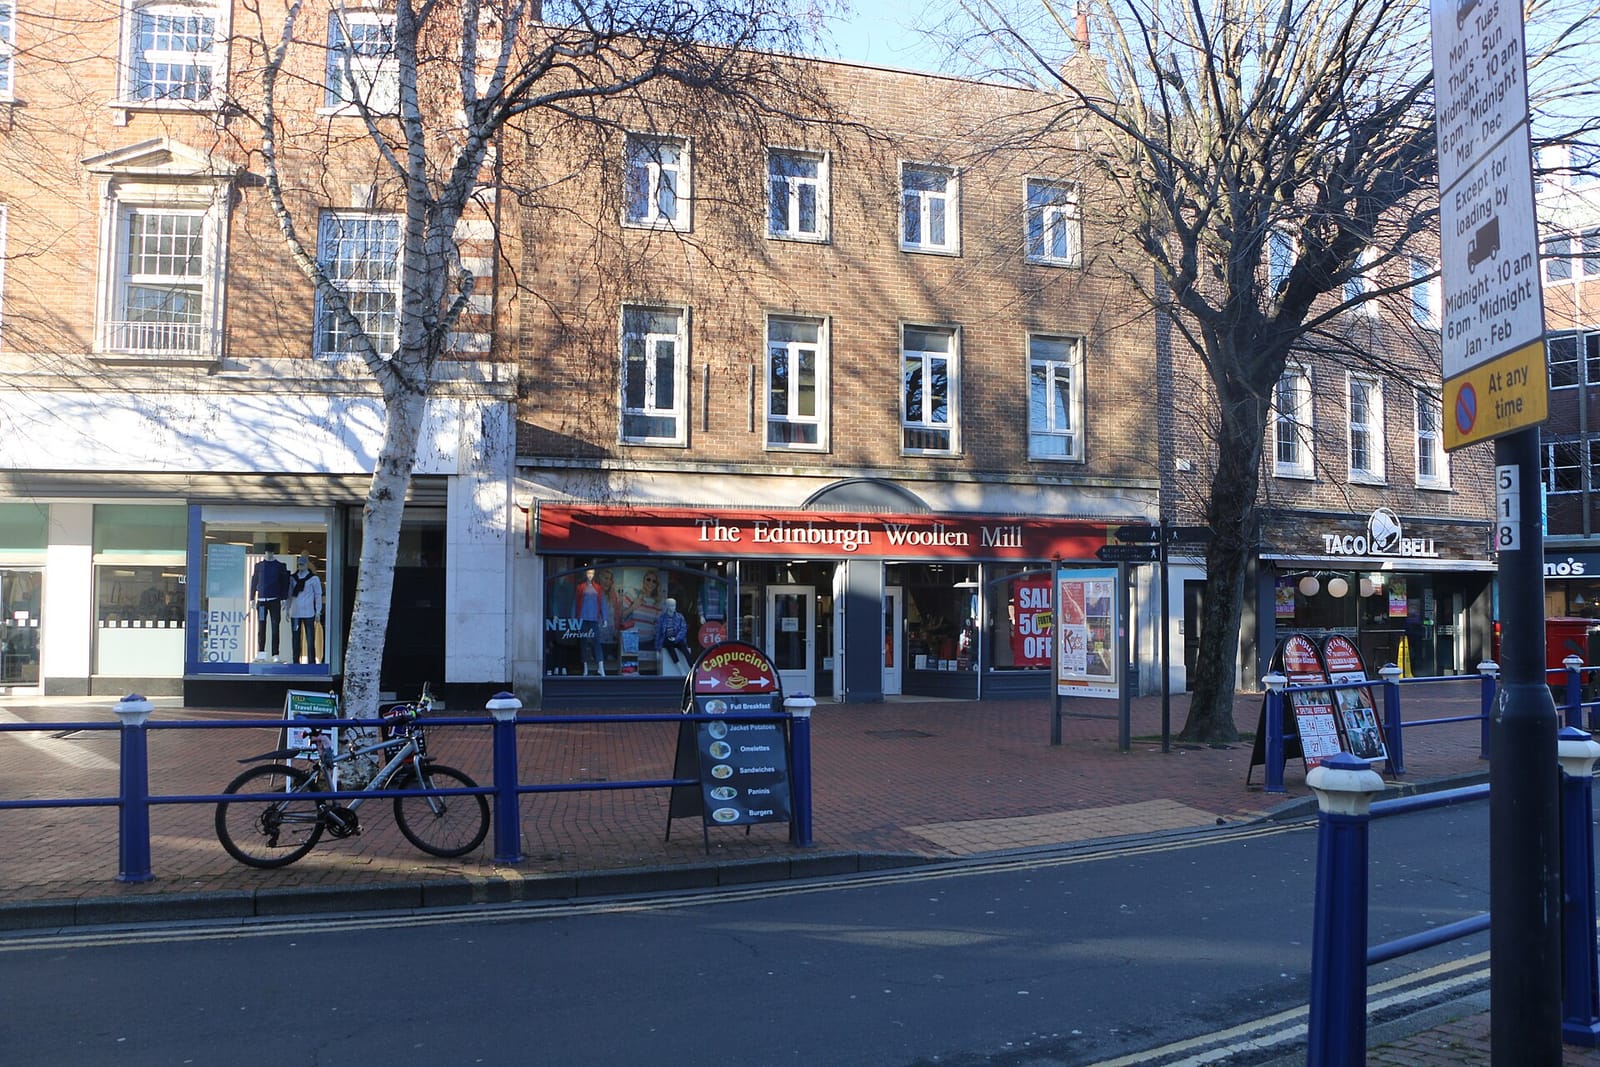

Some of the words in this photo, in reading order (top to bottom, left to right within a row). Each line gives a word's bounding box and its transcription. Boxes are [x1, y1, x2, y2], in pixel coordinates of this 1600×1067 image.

[1449, 40, 1468, 70] Mon
[1475, 1, 1499, 37] Tues
[1448, 56, 1474, 96] Thurs
[1482, 26, 1502, 59] Sun
[1439, 76, 1479, 132] Midnight
[1486, 54, 1499, 81] 10
[1501, 38, 1518, 66] am
[1470, 65, 1517, 127] Midnight
[1456, 138, 1473, 168] Mar
[1481, 113, 1502, 143] Dec
[1455, 170, 1489, 212] Except
[1491, 156, 1507, 181] for
[1456, 198, 1492, 237] loading
[1495, 184, 1509, 206] by
[1445, 274, 1489, 317] Midnight
[1497, 259, 1511, 285] 10
[1514, 252, 1532, 276] am
[1479, 277, 1532, 323] Midnight
[1464, 337, 1482, 358] Jan
[1491, 319, 1512, 345] Feb
[1488, 373, 1502, 395] At
[1506, 365, 1529, 388] any
[1495, 396, 1523, 420] time
[695, 518, 742, 542] The
[752, 520, 872, 551] Edinburgh
[883, 523, 970, 546] Woollen
[980, 526, 1023, 548] Mill
[1321, 534, 1367, 555] TACO
[1402, 538, 1439, 557] BELL
[200, 610, 251, 623] DENIM
[545, 618, 584, 631] NEW
[561, 628, 595, 639] Arrivals
[702, 652, 769, 672] Cappuccino
[743, 702, 771, 710] Breakfast
[740, 766, 775, 774] Sandwiches
[749, 809, 773, 817] Burgers
